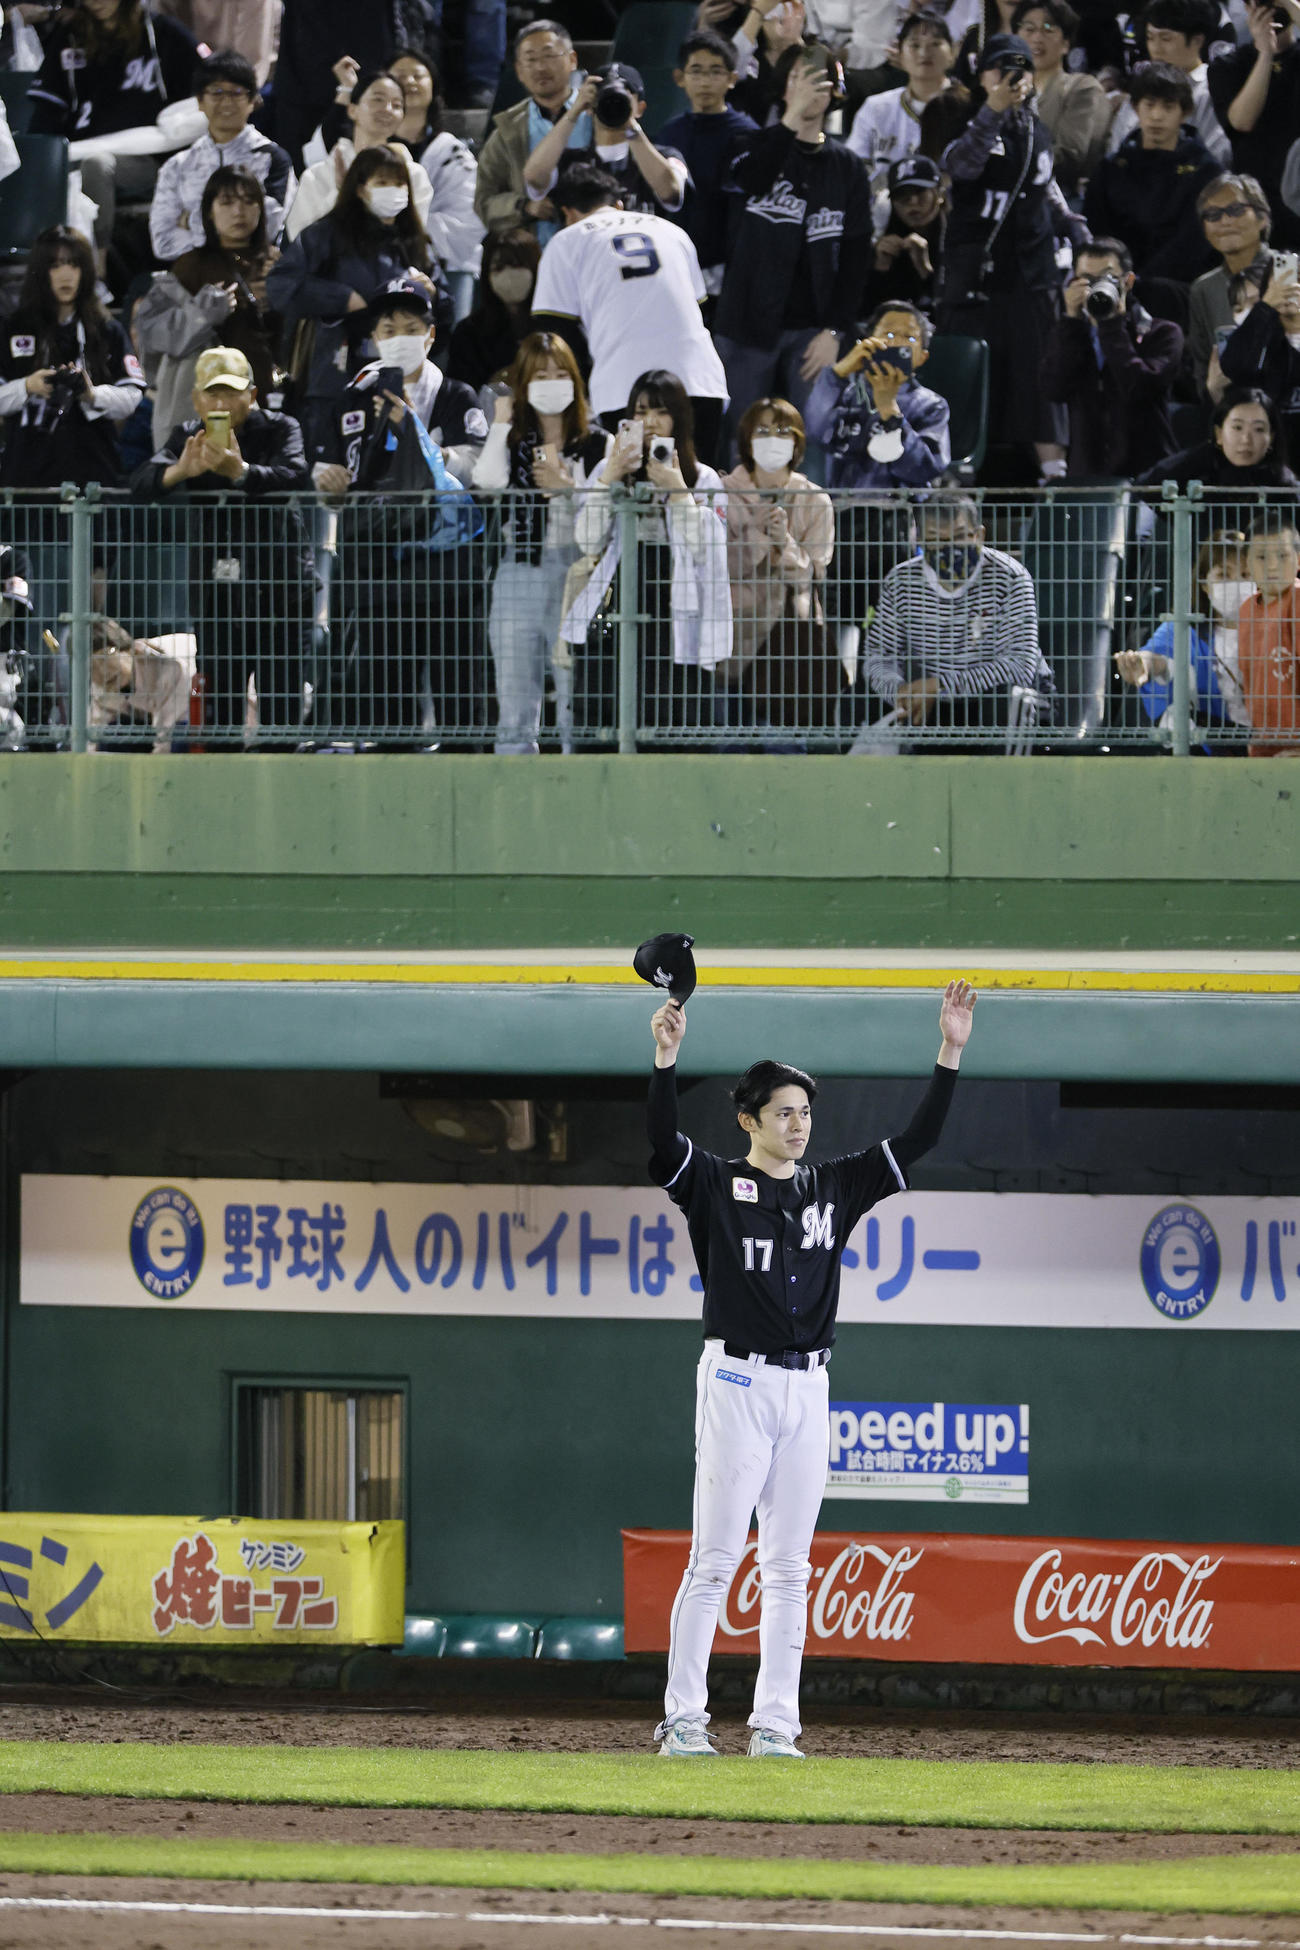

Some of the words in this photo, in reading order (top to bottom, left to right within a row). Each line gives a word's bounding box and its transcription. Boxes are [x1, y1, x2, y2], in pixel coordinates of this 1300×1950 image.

[612, 233, 660, 280] 9
[147, 1207, 187, 1272] e
[801, 1201, 835, 1251] M
[1145, 1224, 1163, 1247] We
[1162, 1211, 1182, 1226] can
[1185, 1211, 1200, 1228] do
[742, 1237, 774, 1271] 17
[1159, 1225, 1200, 1291] e
[1240, 1220, 1300, 1302] バ
[144, 1269, 192, 1296] ENTRY
[1155, 1288, 1206, 1316] ENTRY
[828, 1402, 944, 1463] peed
[955, 1404, 1029, 1467] up!
[847, 1449, 984, 1473] 試合時間マイナス6%
[242, 1540, 303, 1569] ケンミン
[718, 1541, 924, 1641] Co-Cola
[1013, 1549, 1224, 1648] Coca-Cola
